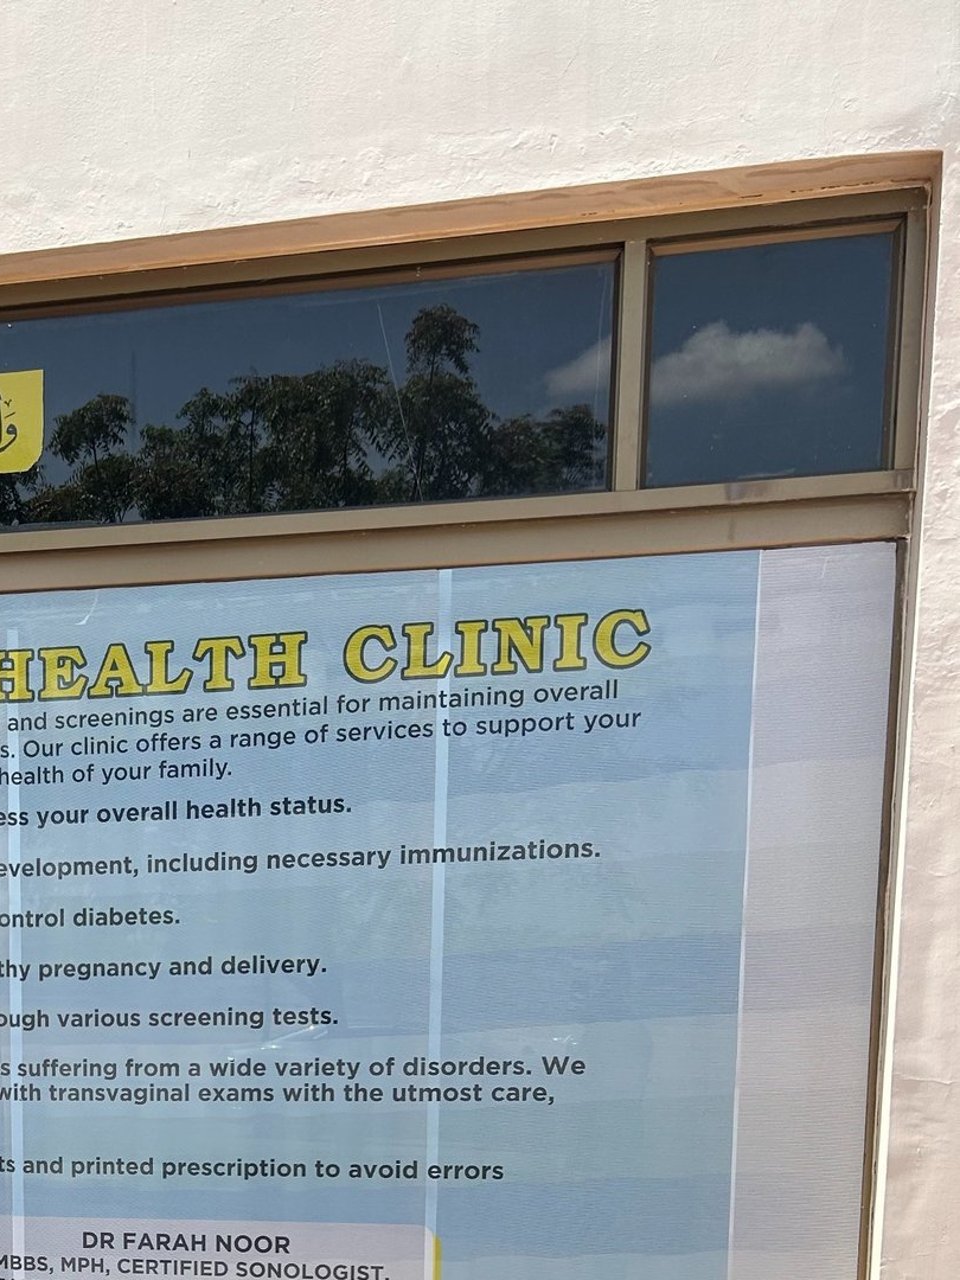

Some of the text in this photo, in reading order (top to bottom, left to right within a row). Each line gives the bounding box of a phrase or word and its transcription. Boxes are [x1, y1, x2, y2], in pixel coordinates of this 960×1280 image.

[342, 608, 652, 685] CLINIC
[7, 711, 47, 732] and
[54, 707, 175, 730] screenings
[182, 706, 218, 723] are
[225, 695, 328, 721] essential
[336, 694, 371, 714] for
[379, 686, 525, 712] maintaining
[533, 678, 618, 704] overall
[22, 739, 64, 759] Our
[70, 735, 129, 756] clinic
[135, 732, 202, 753] offers
[209, 734, 222, 750] a
[230, 730, 296, 750] range
[304, 723, 329, 745] of
[335, 720, 434, 743] services
[441, 718, 468, 737] to
[475, 711, 576, 738] support
[583, 711, 642, 734] your
[71, 763, 95, 783] of
[101, 765, 152, 786] your
[158, 757, 232, 781] family.
[36, 808, 90, 829] your
[96, 800, 178, 823] overall
[186, 797, 262, 820] health
[269, 795, 352, 816] status.
[38, 961, 162, 982] pregnancy
[168, 955, 213, 976] and
[220, 954, 327, 977] delivery.
[56, 1008, 141, 1028] various
[148, 1006, 264, 1030] screening
[272, 1007, 339, 1026] tests.
[17, 1057, 117, 1080] suffering
[124, 1057, 180, 1078] from
[187, 1062, 201, 1077] a
[209, 1057, 267, 1077] wide
[274, 1057, 361, 1081] variety
[368, 1056, 396, 1077] of
[402, 1055, 532, 1077] disorders.
[541, 1055, 586, 1076] We
[82, 1231, 290, 1255] DR FARAH NOOR
[60, 1256, 111, 1277] MPH,
[117, 1258, 229, 1277] CERTIFIED
